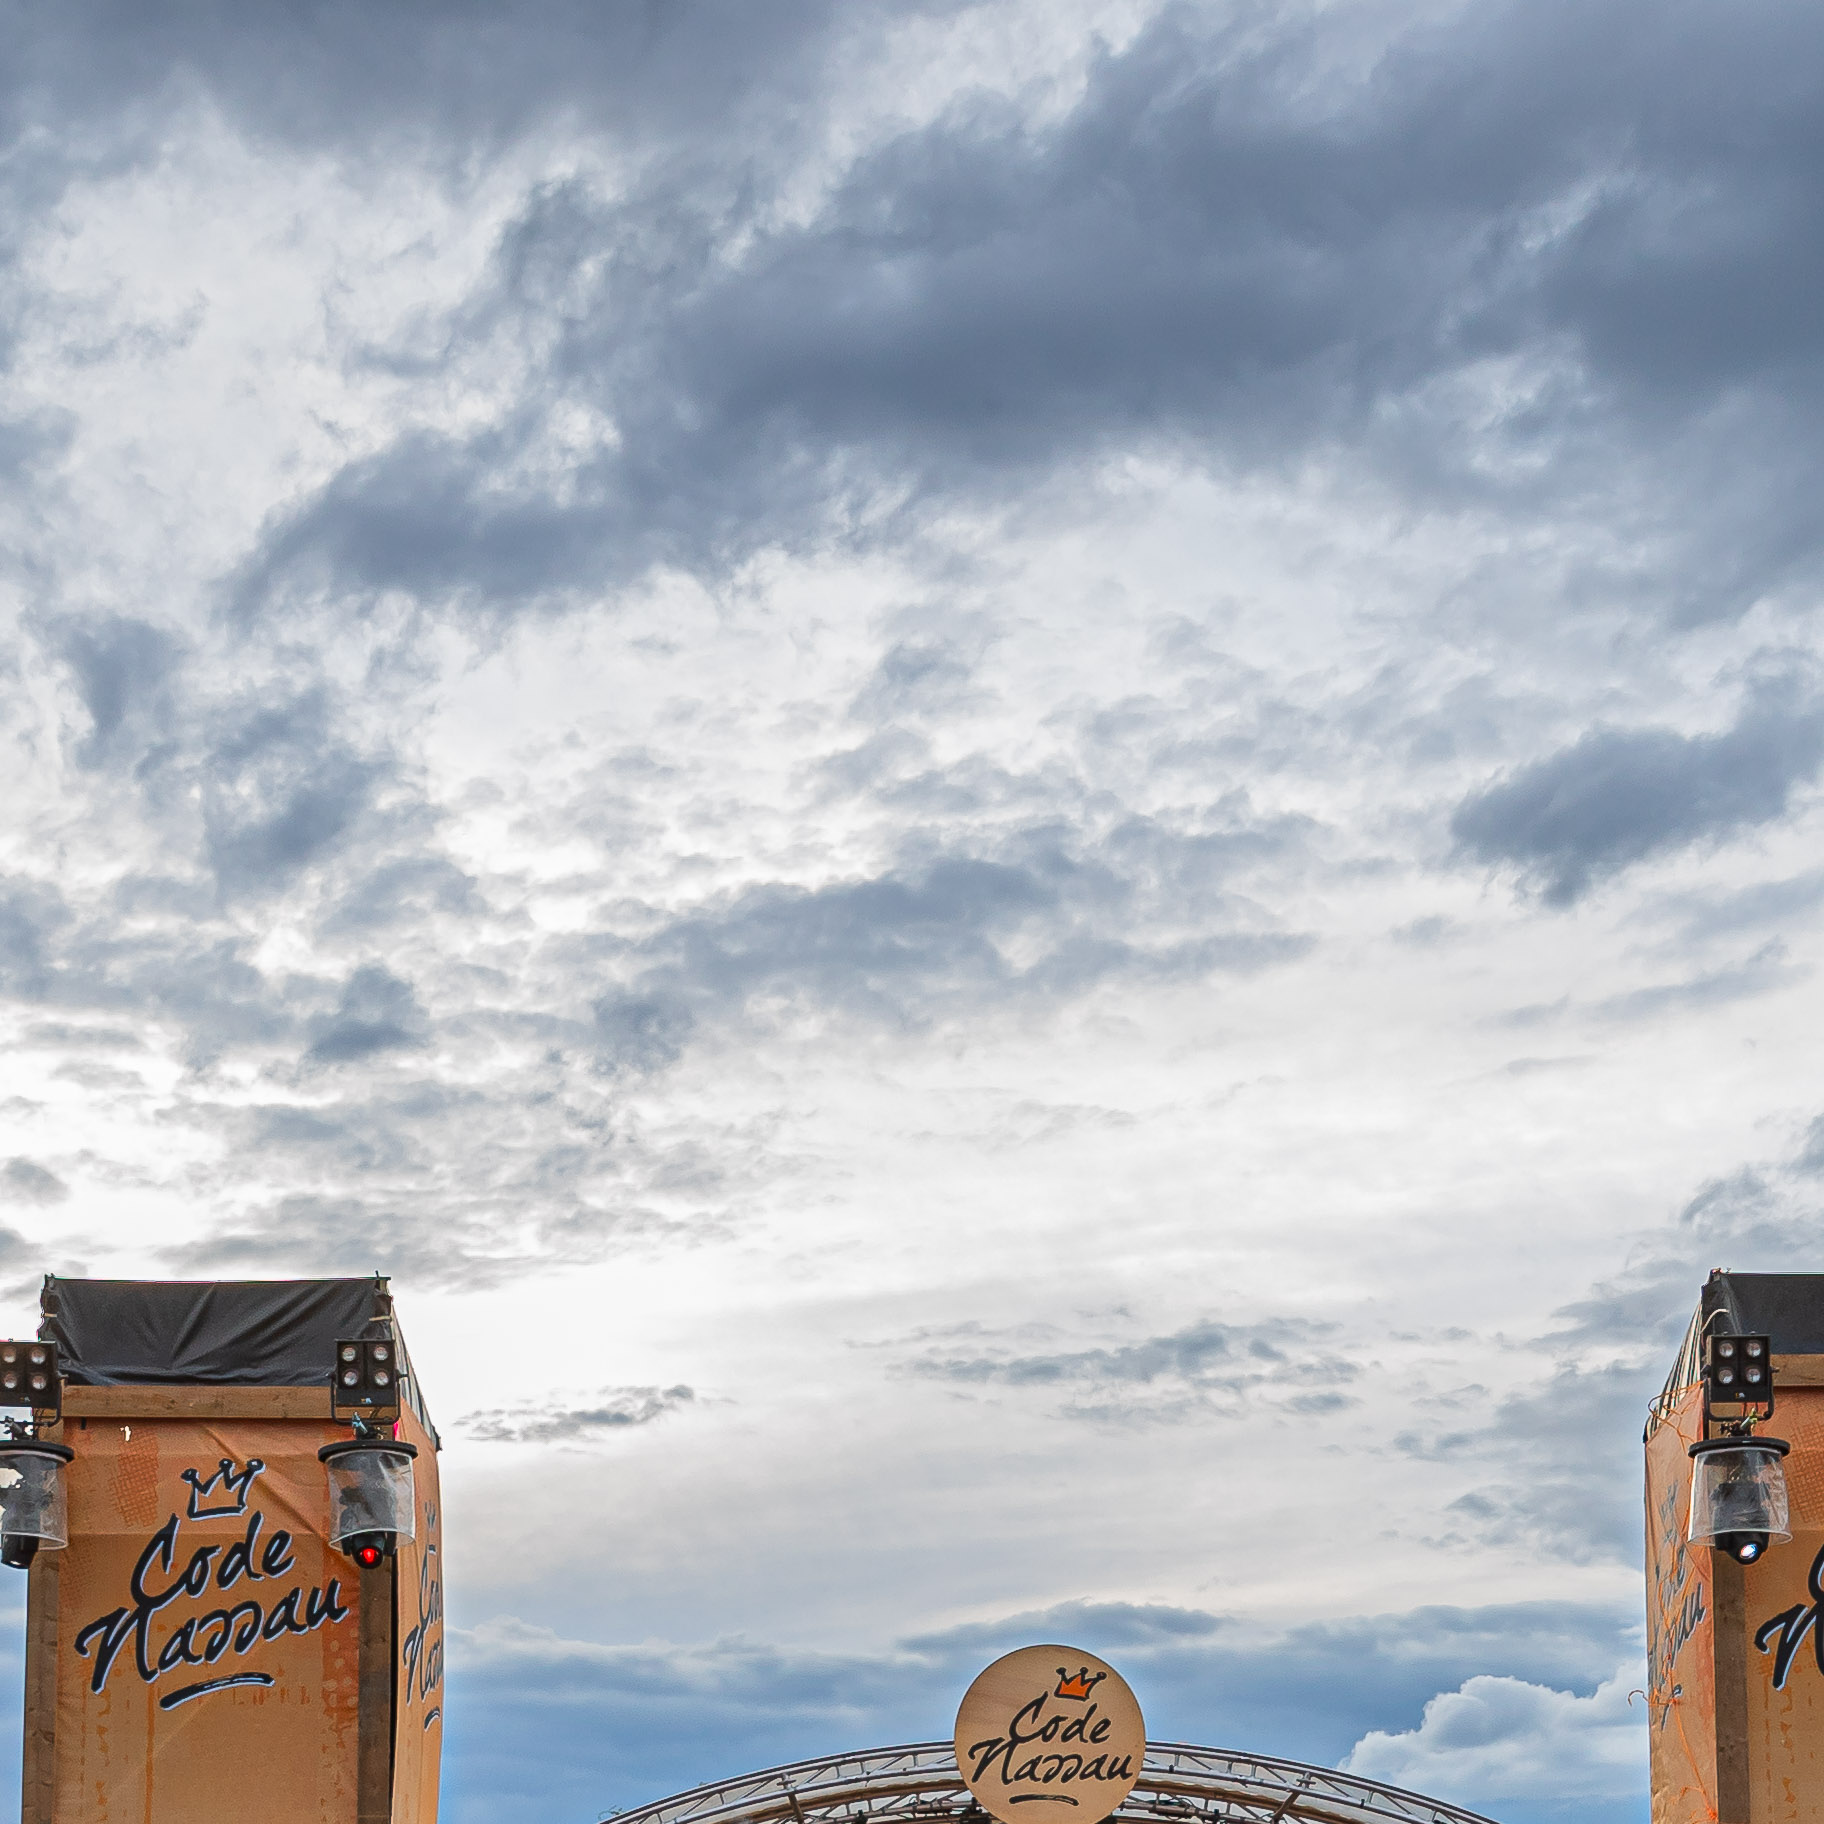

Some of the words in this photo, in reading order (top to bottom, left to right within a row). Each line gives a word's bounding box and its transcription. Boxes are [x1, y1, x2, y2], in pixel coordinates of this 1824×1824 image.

[130, 1512, 297, 1609] Code
[74, 1577, 350, 1695] Nassau
[1008, 1690, 1112, 1744] Code
[967, 1736, 1134, 1786] Nassau
